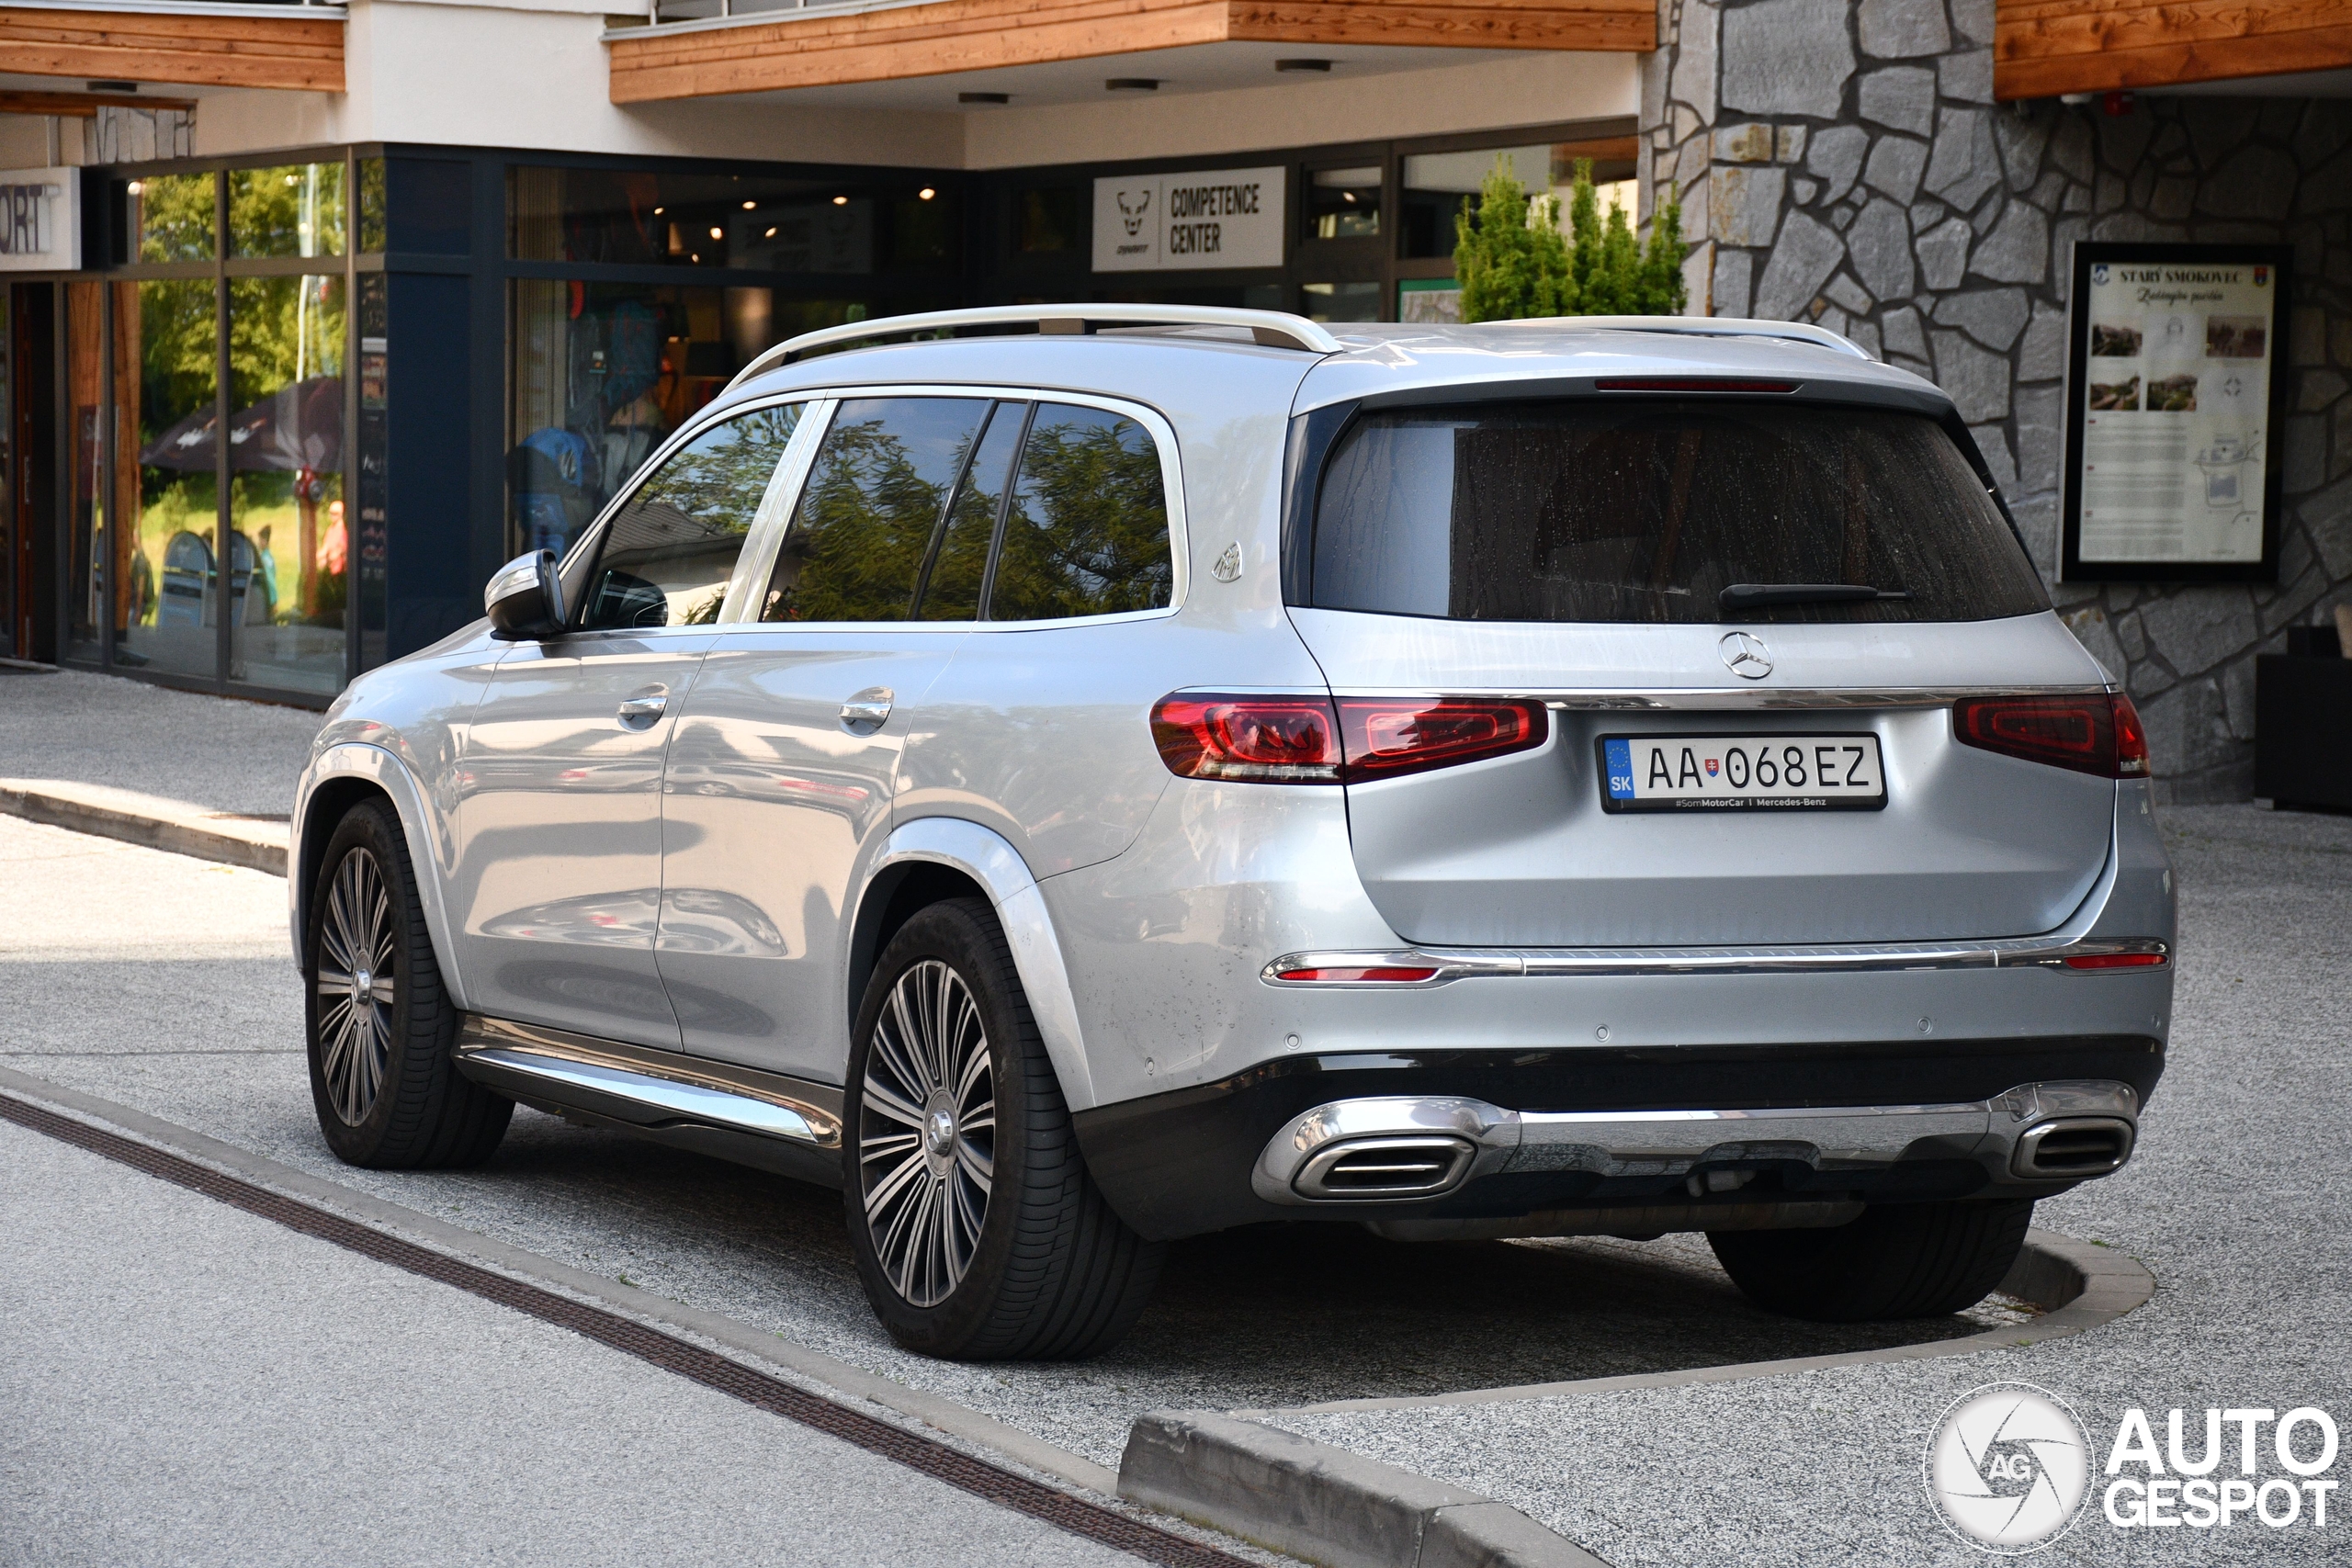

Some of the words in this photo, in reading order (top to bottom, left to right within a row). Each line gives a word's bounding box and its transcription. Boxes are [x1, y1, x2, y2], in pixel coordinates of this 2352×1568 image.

[1170, 184, 1260, 219] COMPETENCE
[1170, 222, 1221, 254] CENTER
[2165, 270, 2241, 283] SMOKOVEC
[1611, 776, 1632, 792] SK
[1676, 798, 1745, 808] #SomMotorCar
[1757, 797, 1827, 807] Mercedes-Benz
